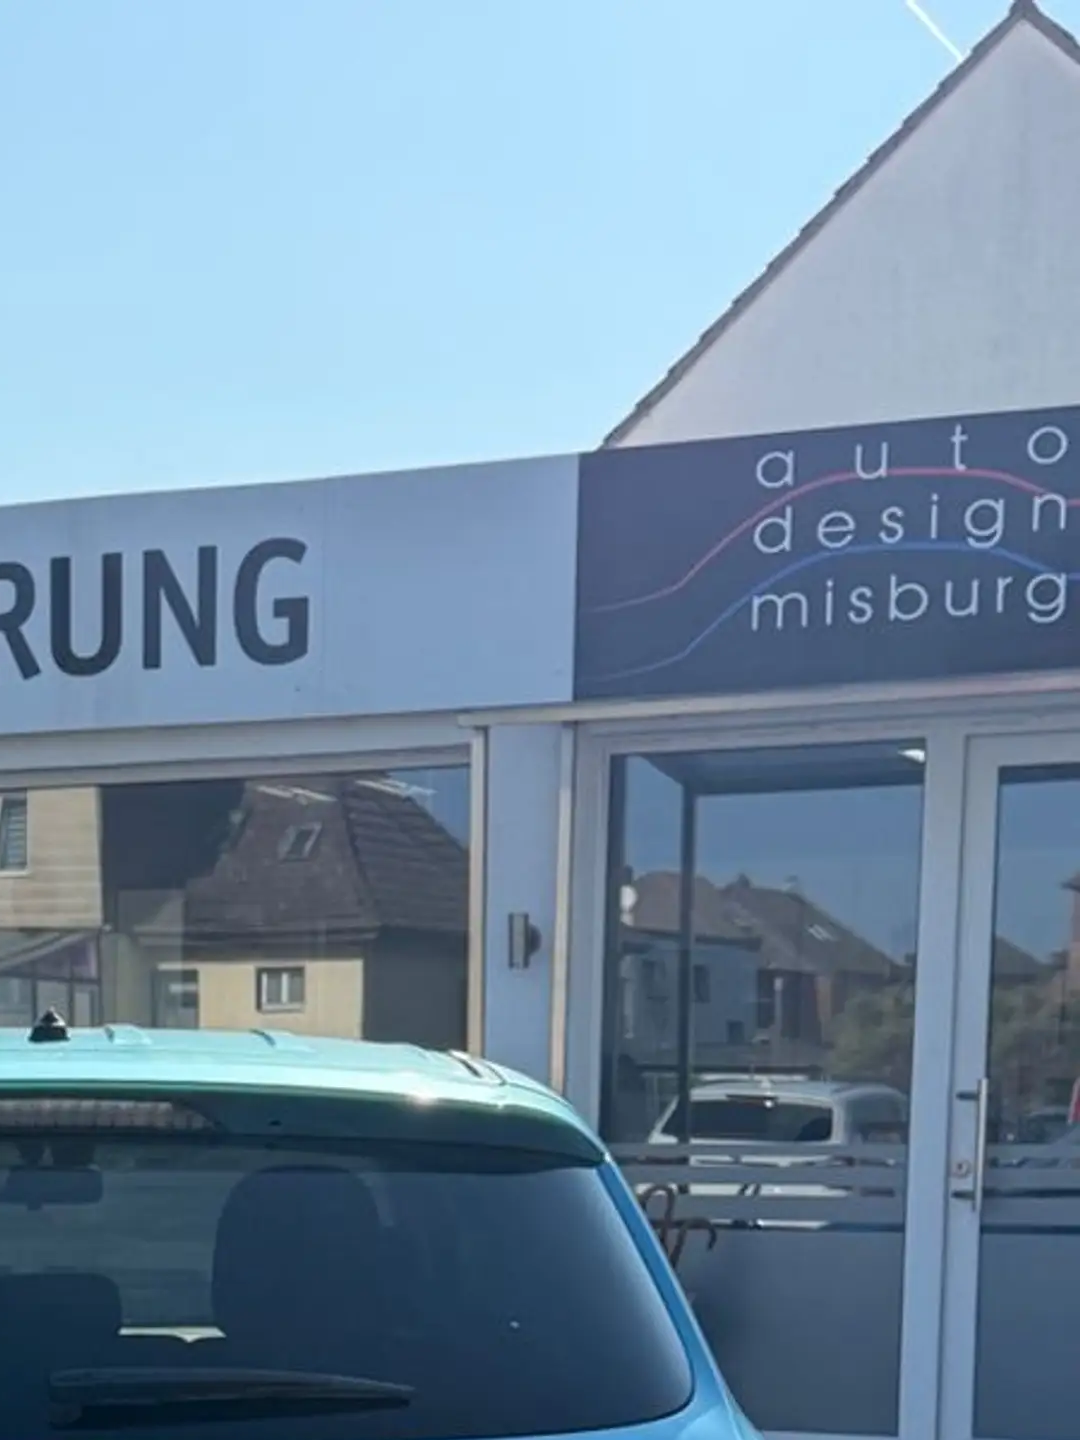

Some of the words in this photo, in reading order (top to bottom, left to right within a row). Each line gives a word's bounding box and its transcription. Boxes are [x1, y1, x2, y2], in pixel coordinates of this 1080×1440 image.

[756, 424, 1067, 487] auto
[753, 493, 1067, 554] design
[751, 572, 1067, 631] misburg
